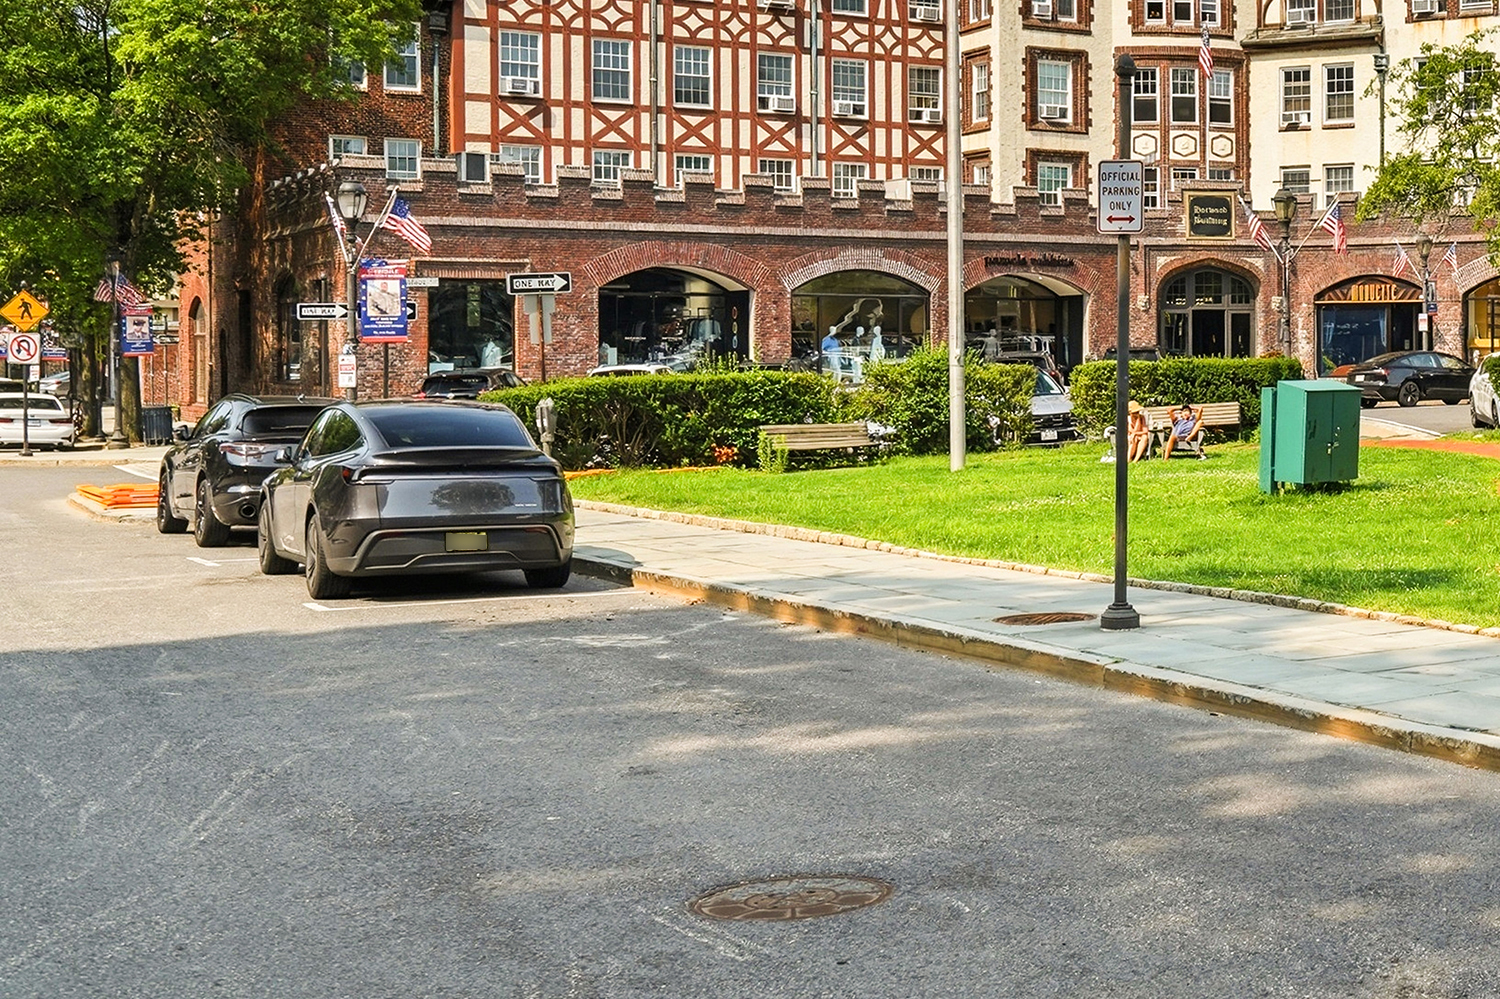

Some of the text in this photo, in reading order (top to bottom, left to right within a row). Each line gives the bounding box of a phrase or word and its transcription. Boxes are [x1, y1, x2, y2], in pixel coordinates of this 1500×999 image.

[1101, 171, 1140, 182] OFFICIAL
[1102, 186, 1140, 196] PARKING
[1109, 201, 1132, 211] ONLY
[514, 279, 556, 288] ONE WAY
